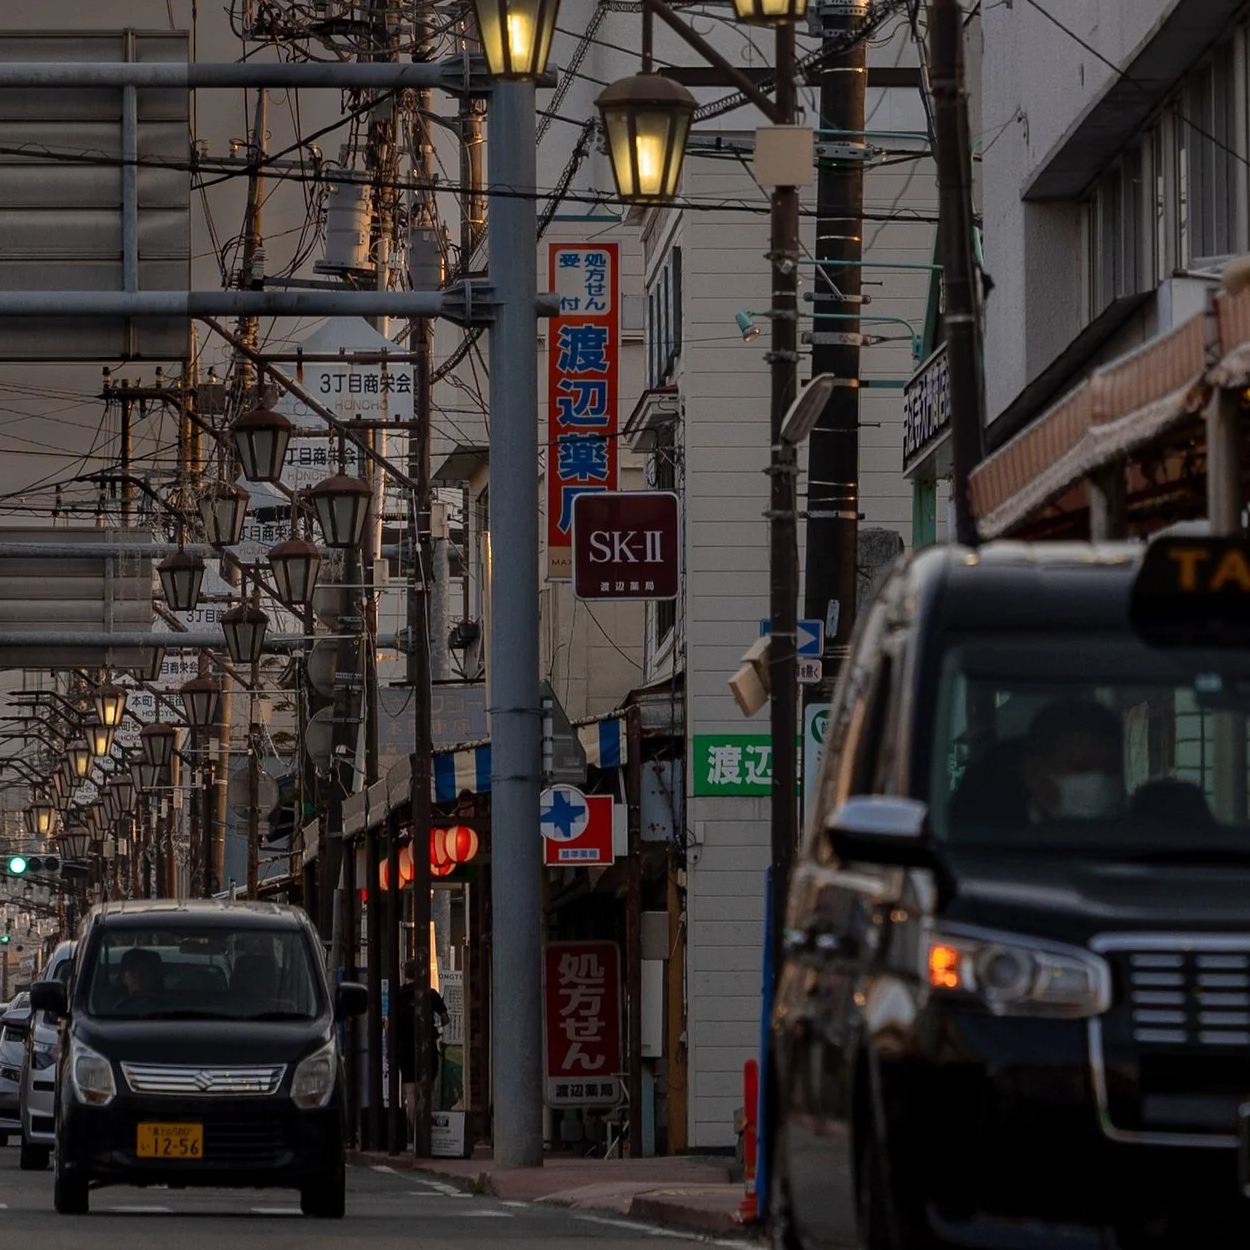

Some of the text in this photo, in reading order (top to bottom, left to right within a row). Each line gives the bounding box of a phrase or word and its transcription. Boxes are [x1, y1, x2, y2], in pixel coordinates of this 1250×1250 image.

[559, 253, 581, 311] 受付
[584, 253, 606, 311] 処方せん
[320, 373, 411, 394] 3丁目商栄会
[600, 581, 655, 593] 渡辺薬局
[557, 953, 607, 1071] 処方せん
[555, 1082, 614, 1098] 渡辺薬局
[154, 1137, 199, 1155] 12-56
